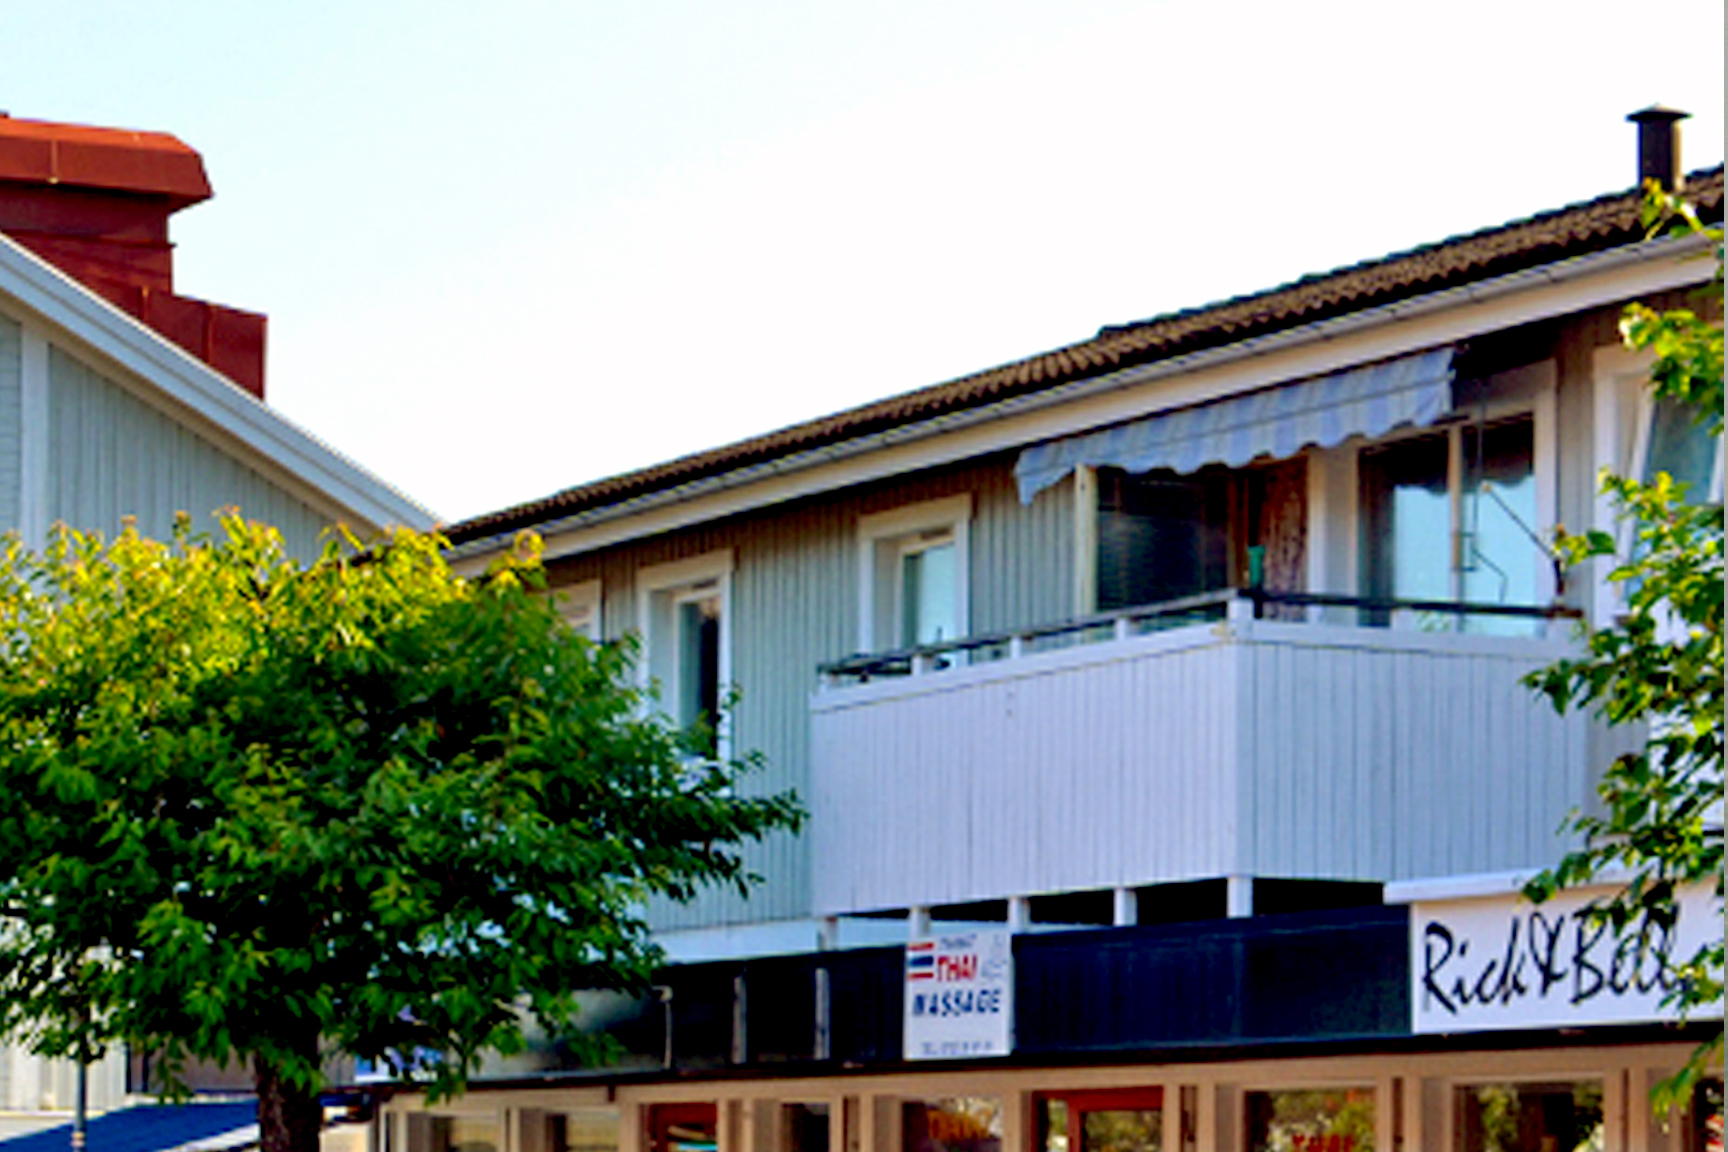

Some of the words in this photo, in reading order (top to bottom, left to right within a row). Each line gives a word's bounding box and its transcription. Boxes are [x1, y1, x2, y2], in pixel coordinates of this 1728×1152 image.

[937, 954, 978, 982] THAI
[1423, 912, 1527, 1016] Rich
[913, 989, 1001, 1017] MASSAGE
